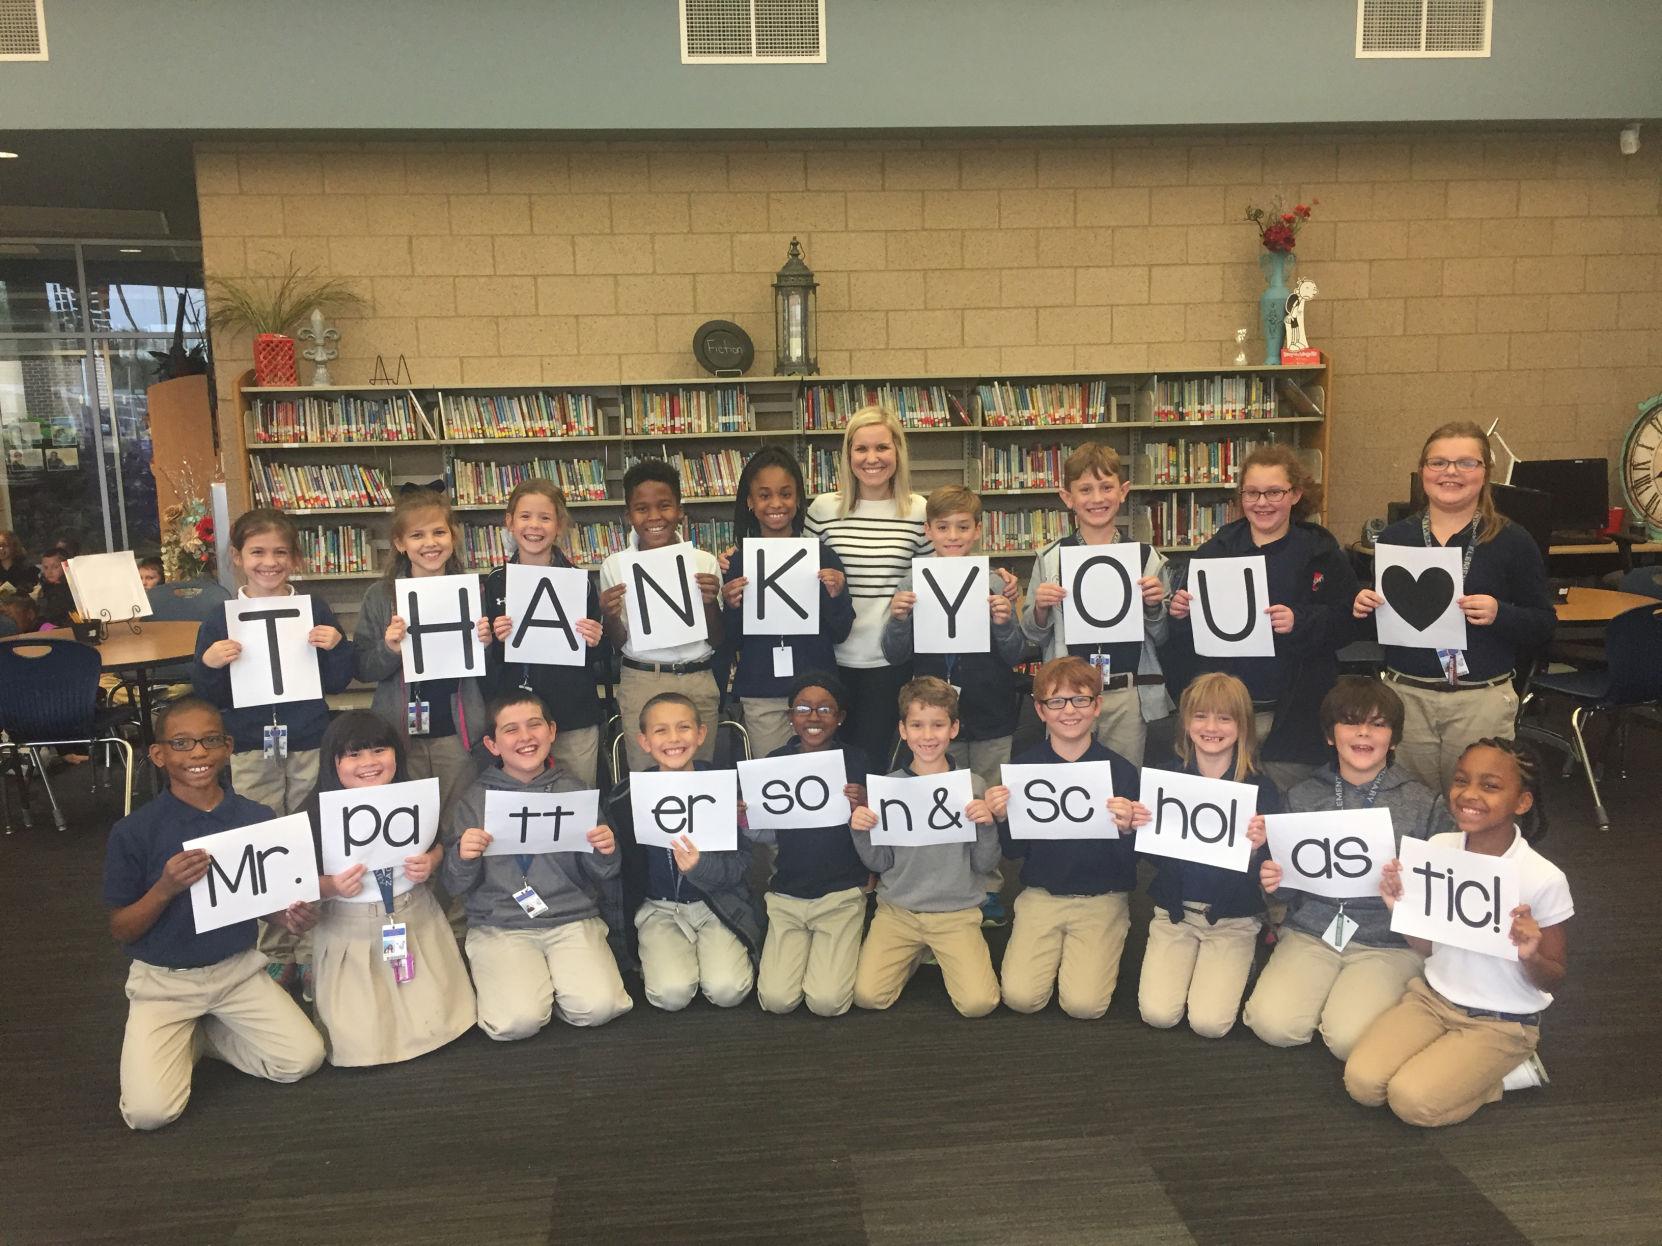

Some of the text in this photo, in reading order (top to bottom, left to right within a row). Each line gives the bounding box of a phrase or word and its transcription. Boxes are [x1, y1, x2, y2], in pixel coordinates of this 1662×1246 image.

[707, 338, 743, 354] Fiction
[512, 577, 579, 651] A
[633, 555, 694, 634] N
[757, 549, 808, 620] K
[922, 567, 979, 638] Y
[1073, 556, 1132, 628] O
[1198, 568, 1256, 642] U
[239, 609, 300, 695] T
[407, 588, 475, 674] H
[509, 806, 574, 847] tt
[652, 795, 716, 833] er
[762, 776, 829, 814] so
[880, 788, 962, 831] n &
[1156, 788, 1236, 847] hol
[343, 804, 419, 856] pa
[1292, 837, 1372, 878] as
[207, 844, 302, 907] Mr.
[1413, 862, 1501, 933] tic!
